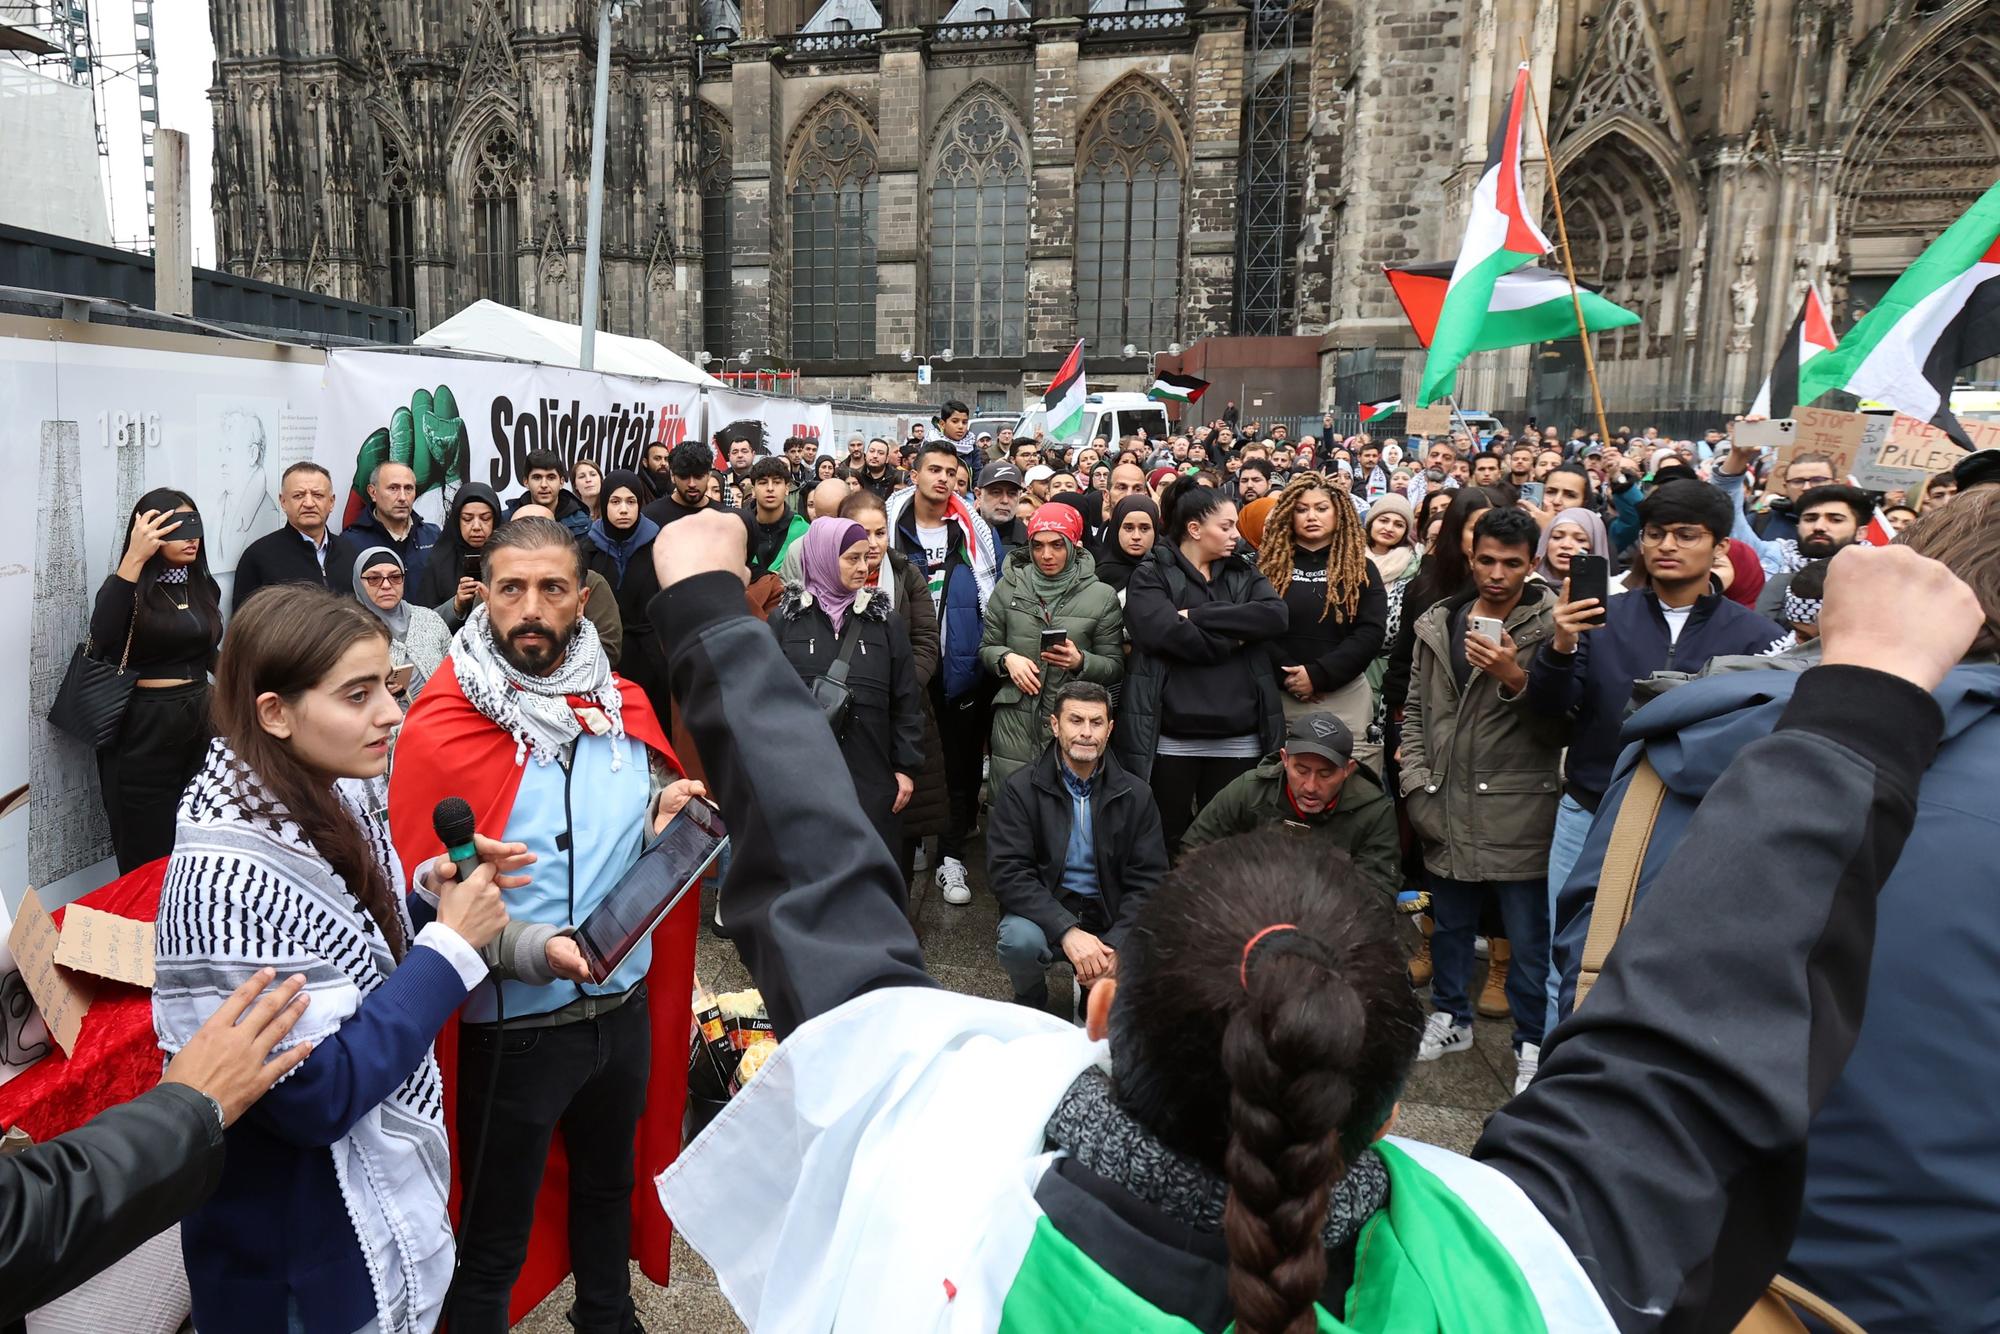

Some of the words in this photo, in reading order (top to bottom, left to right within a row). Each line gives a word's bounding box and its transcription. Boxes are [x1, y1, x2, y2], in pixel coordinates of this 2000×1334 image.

[97, 409, 161, 447] 1816
[1802, 411, 1856, 428] STOP
[490, 396, 655, 492] Solidarität
[657, 404, 687, 452] für
[1815, 432, 1842, 447] THE
